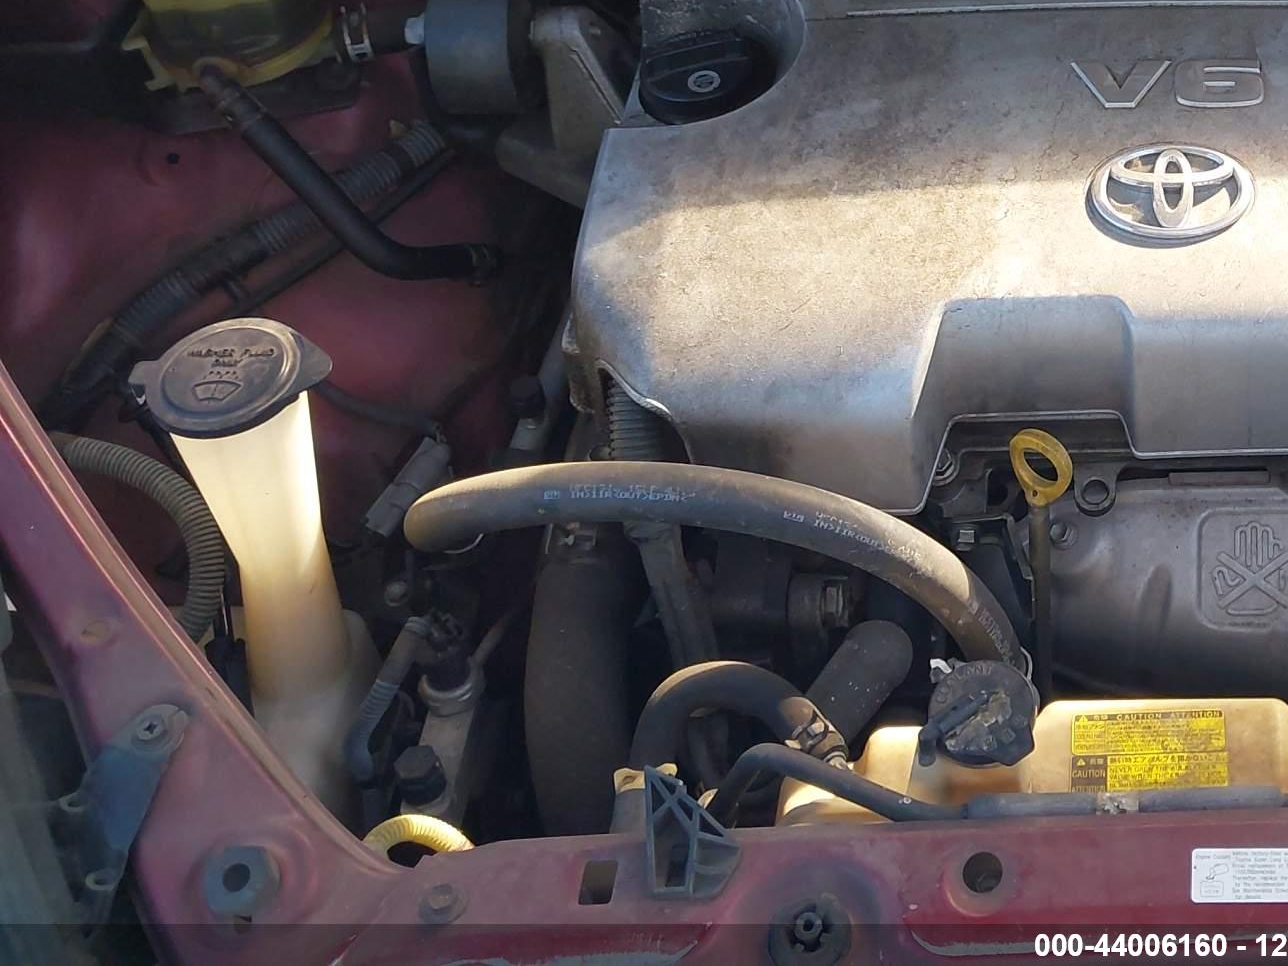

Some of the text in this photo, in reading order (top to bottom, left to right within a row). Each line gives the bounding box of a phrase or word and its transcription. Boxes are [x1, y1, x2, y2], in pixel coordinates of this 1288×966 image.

[1070, 58, 1265, 109] V6
[1116, 712, 1162, 721] CAUTION
[1072, 769, 1106, 779] CAUTION
